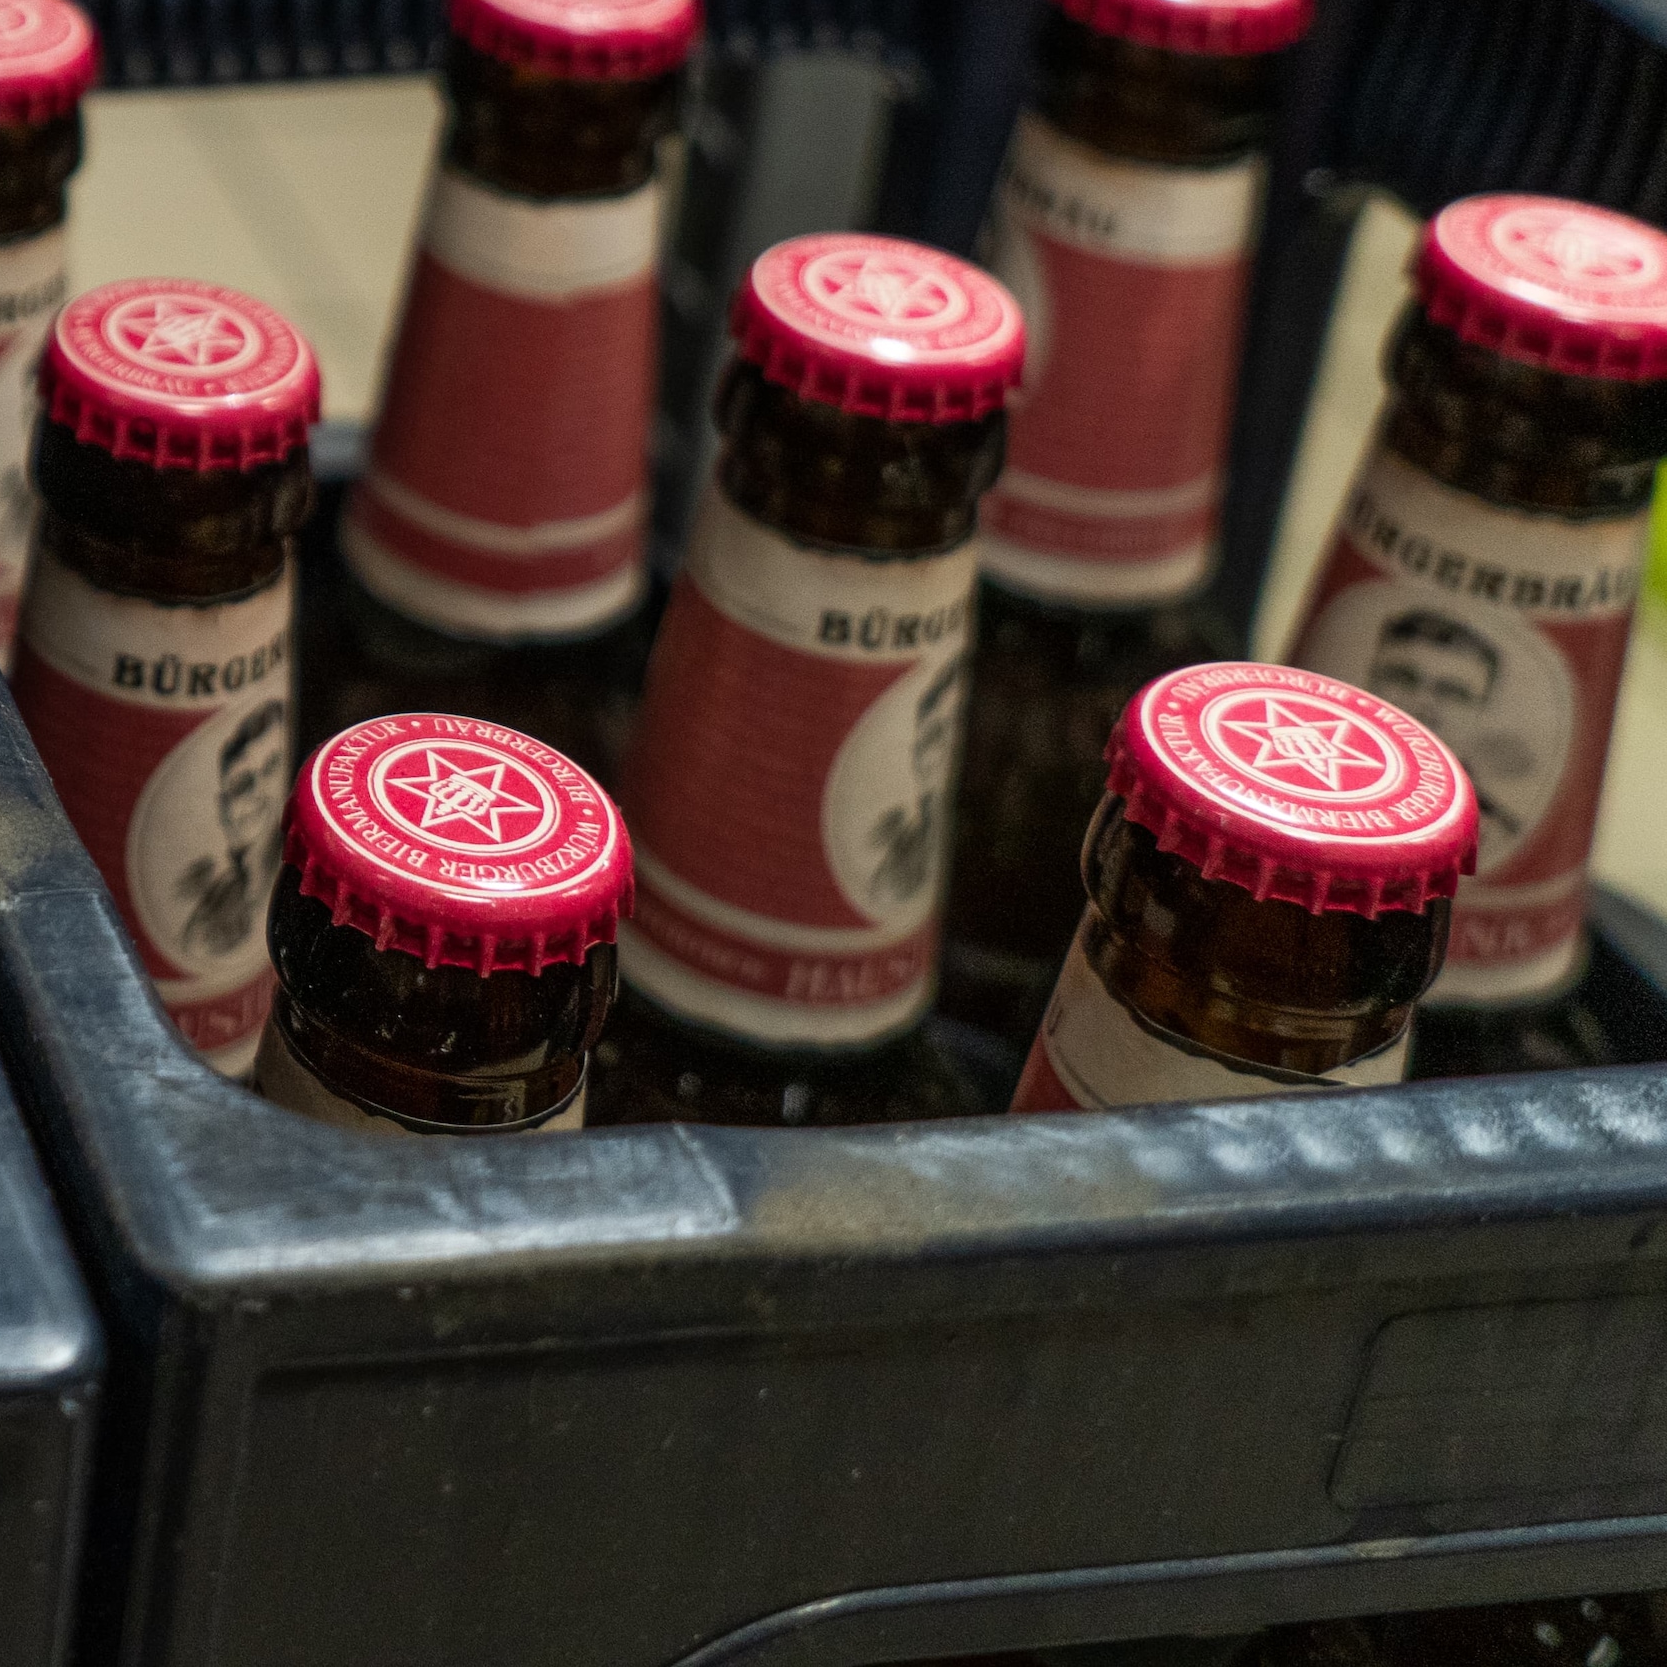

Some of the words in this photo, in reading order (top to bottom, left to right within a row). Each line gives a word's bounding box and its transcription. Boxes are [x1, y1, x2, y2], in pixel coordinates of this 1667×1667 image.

[327, 719, 428, 870] BIERMANUFAKTUR
[432, 717, 596, 805] BÜRGERBRÄU
[1372, 707, 1450, 824] WÜRZBURGER
[438, 821, 601, 884] WÜRZBURGER
